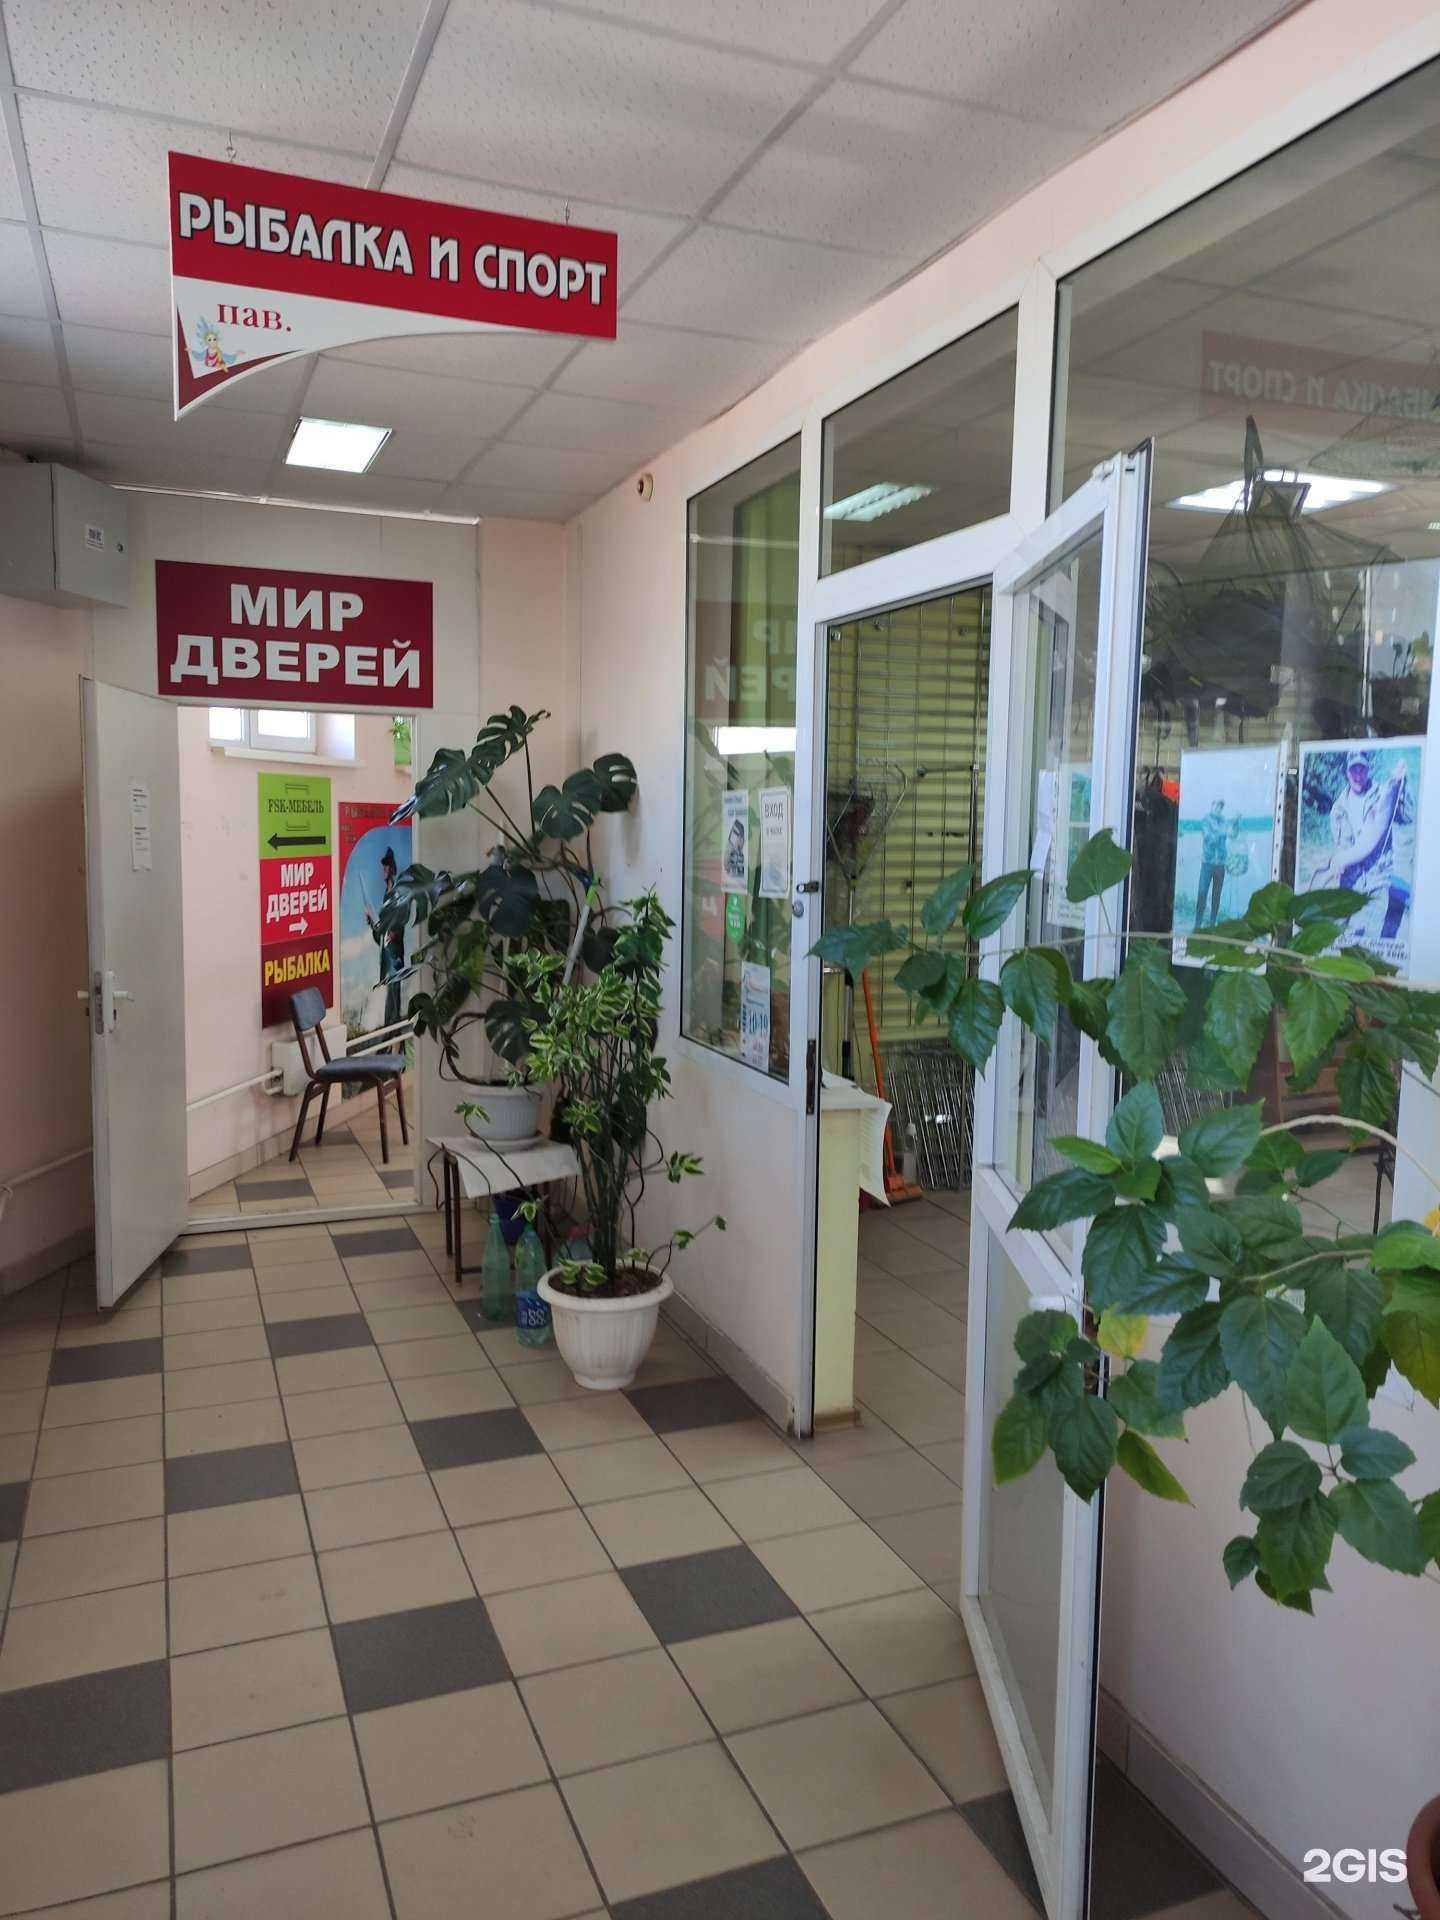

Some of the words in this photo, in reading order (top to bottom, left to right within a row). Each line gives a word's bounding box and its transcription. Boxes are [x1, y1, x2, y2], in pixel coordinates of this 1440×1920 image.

[178, 191, 415, 275] РЫБАЛКА
[430, 234, 459, 283] И
[473, 243, 608, 306] СПОРТ
[216, 303, 293, 333] пав.
[230, 583, 364, 633] МИР
[169, 633, 421, 689] ДВЕРЕЙ
[280, 862, 315, 888] МИР
[265, 884, 328, 924] ДВЕРЕЙ
[264, 948, 331, 987] РЫБАЛКА
